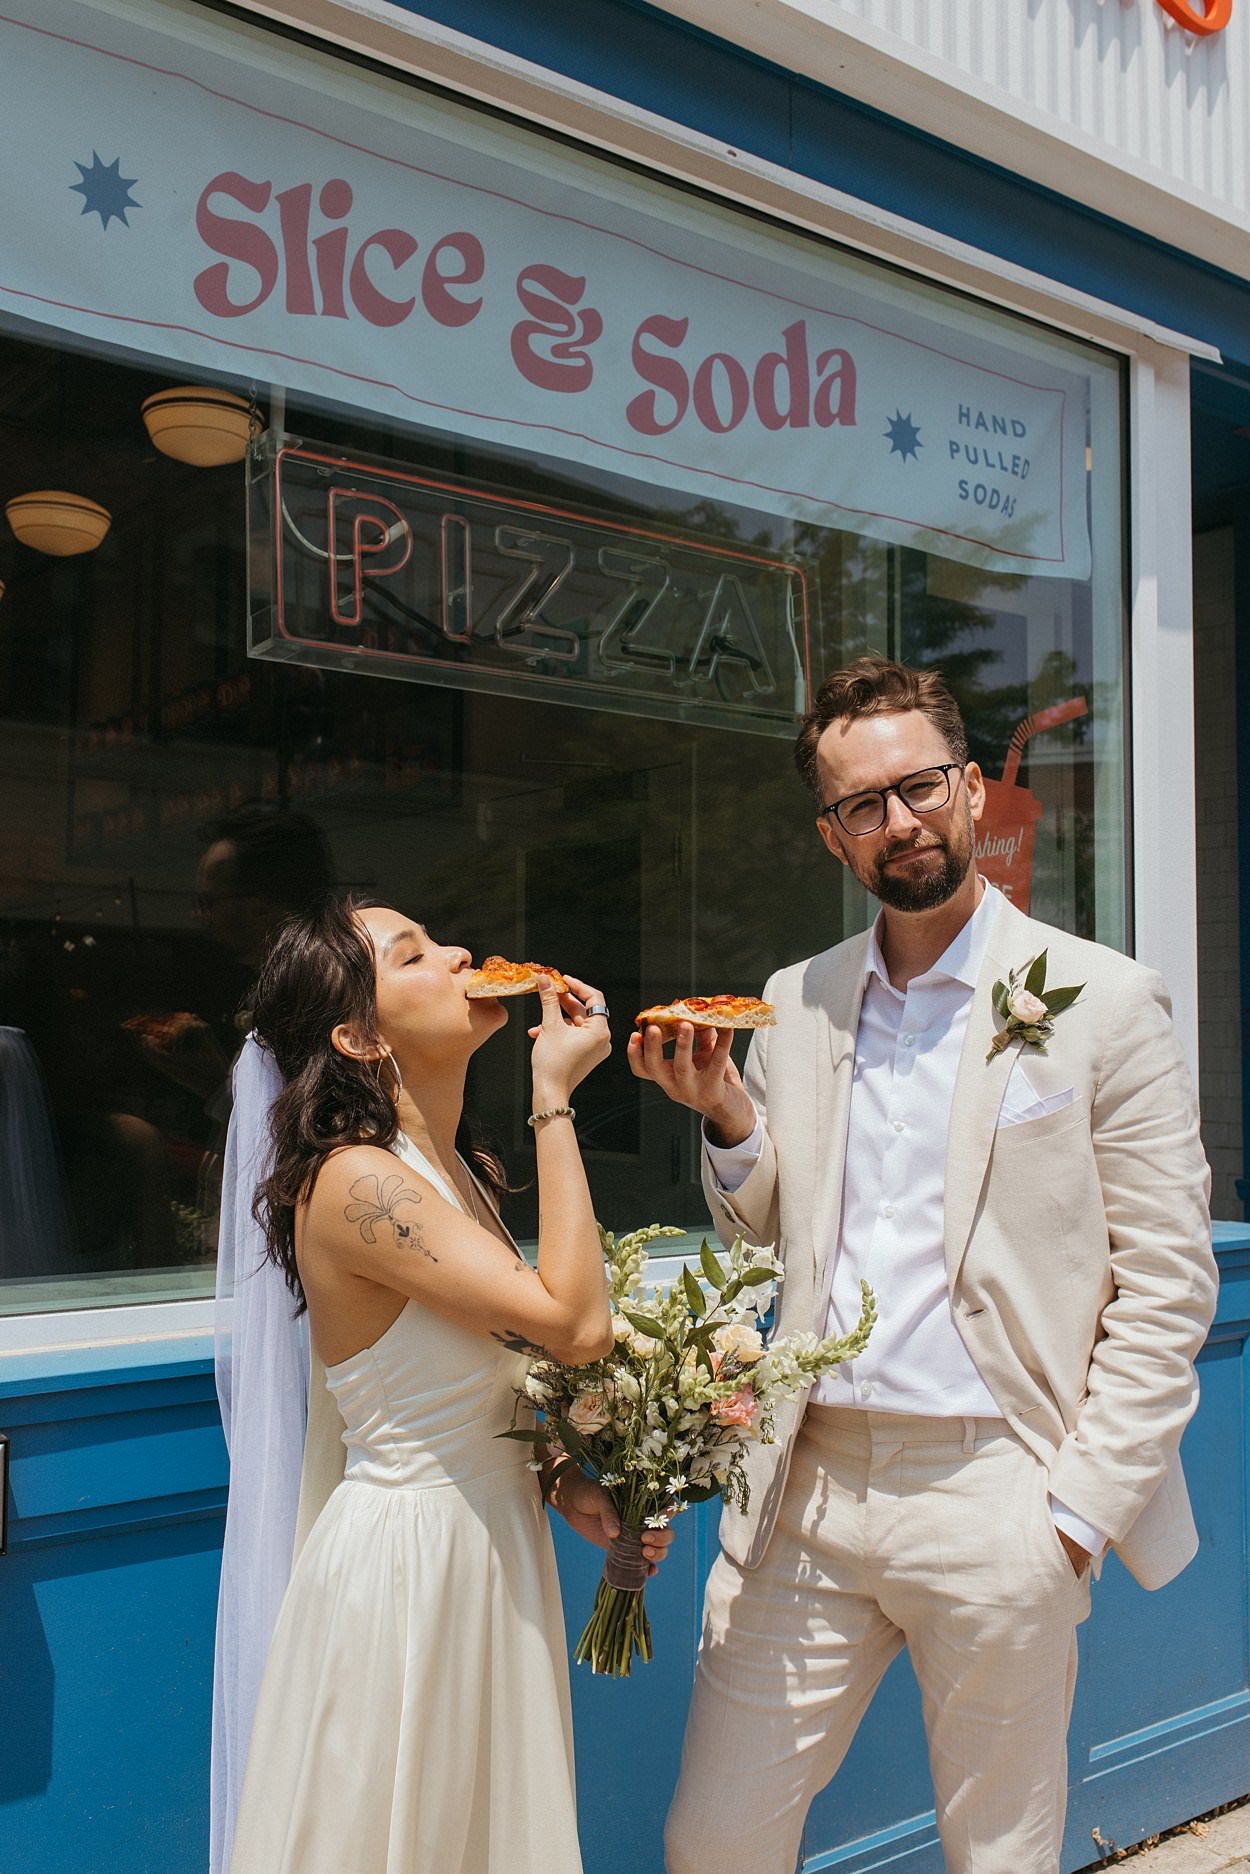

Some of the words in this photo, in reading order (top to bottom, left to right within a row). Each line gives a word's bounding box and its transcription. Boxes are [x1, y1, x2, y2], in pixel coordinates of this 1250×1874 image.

[193, 171, 485, 328] Slice
[510, 264, 603, 393] &
[626, 314, 857, 436] Soda
[957, 404, 1027, 439] HAND
[949, 441, 1031, 481] PULLED
[957, 479, 1018, 518] SODAS
[328, 488, 776, 694] PIZZA
